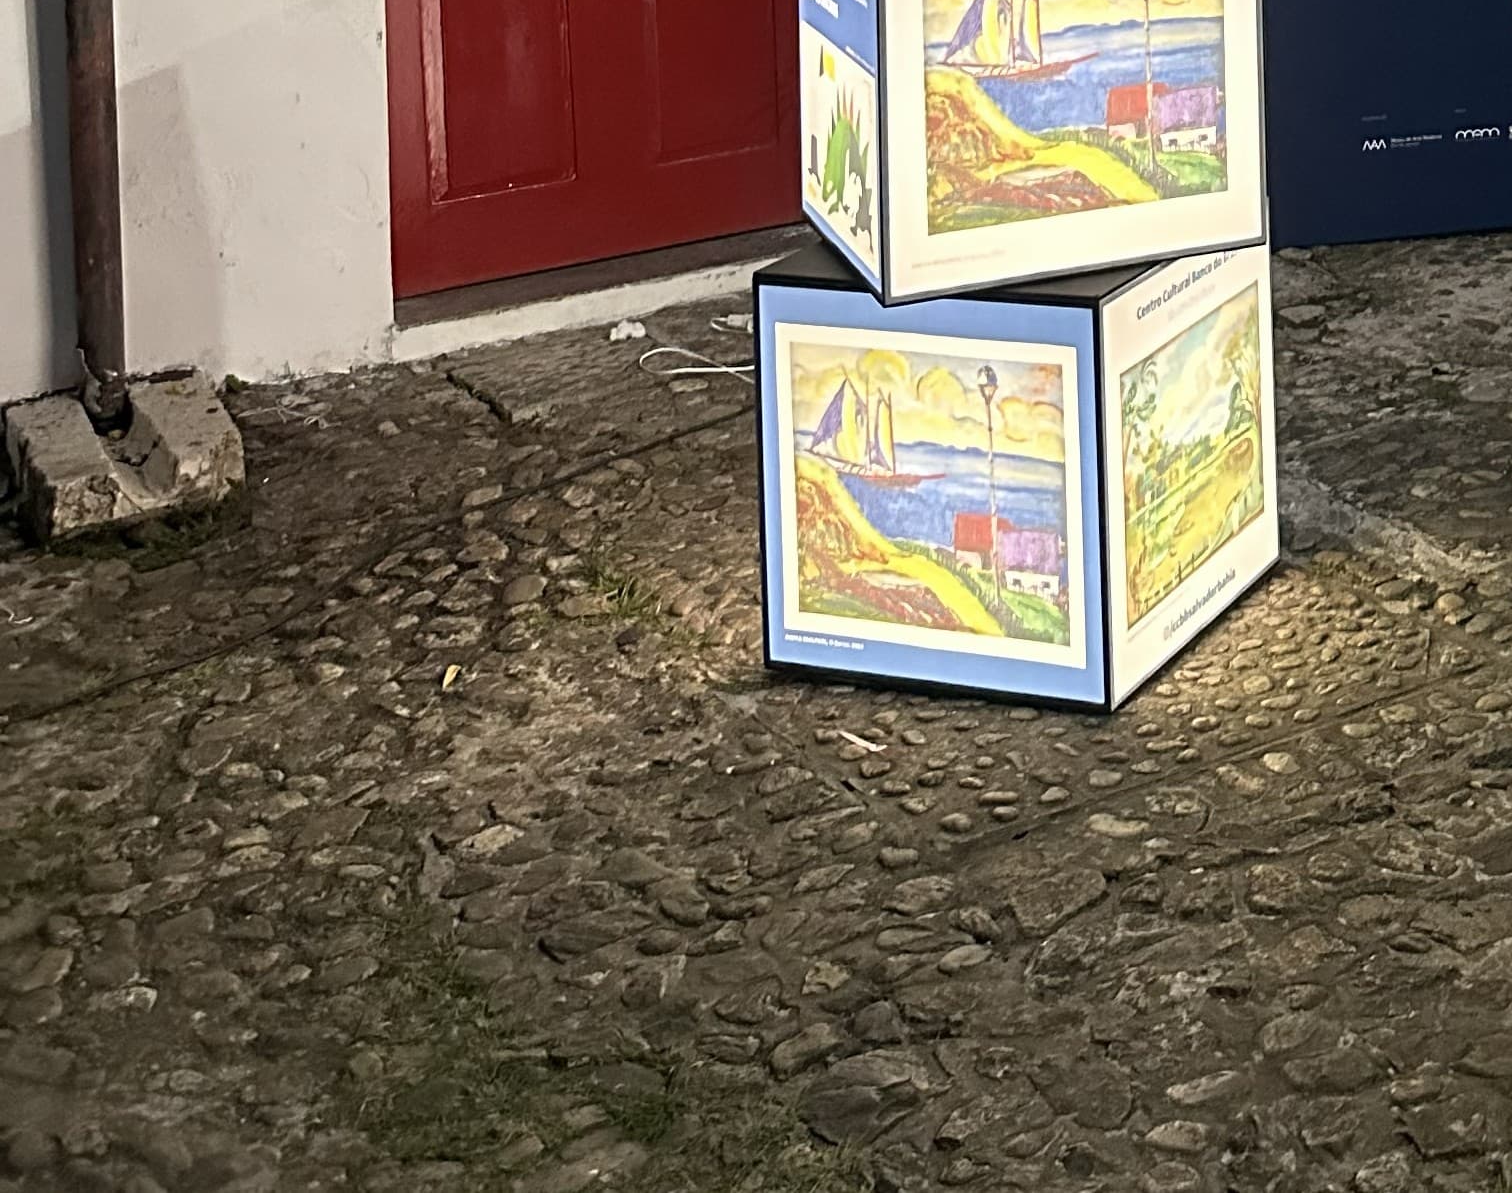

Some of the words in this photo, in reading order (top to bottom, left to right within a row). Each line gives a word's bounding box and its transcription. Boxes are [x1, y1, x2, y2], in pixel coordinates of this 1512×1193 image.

[1136, 296, 1162, 321] Centro
[1162, 272, 1191, 303] Cultural
[1191, 263, 1213, 284] Banco
[1213, 254, 1223, 270] do
